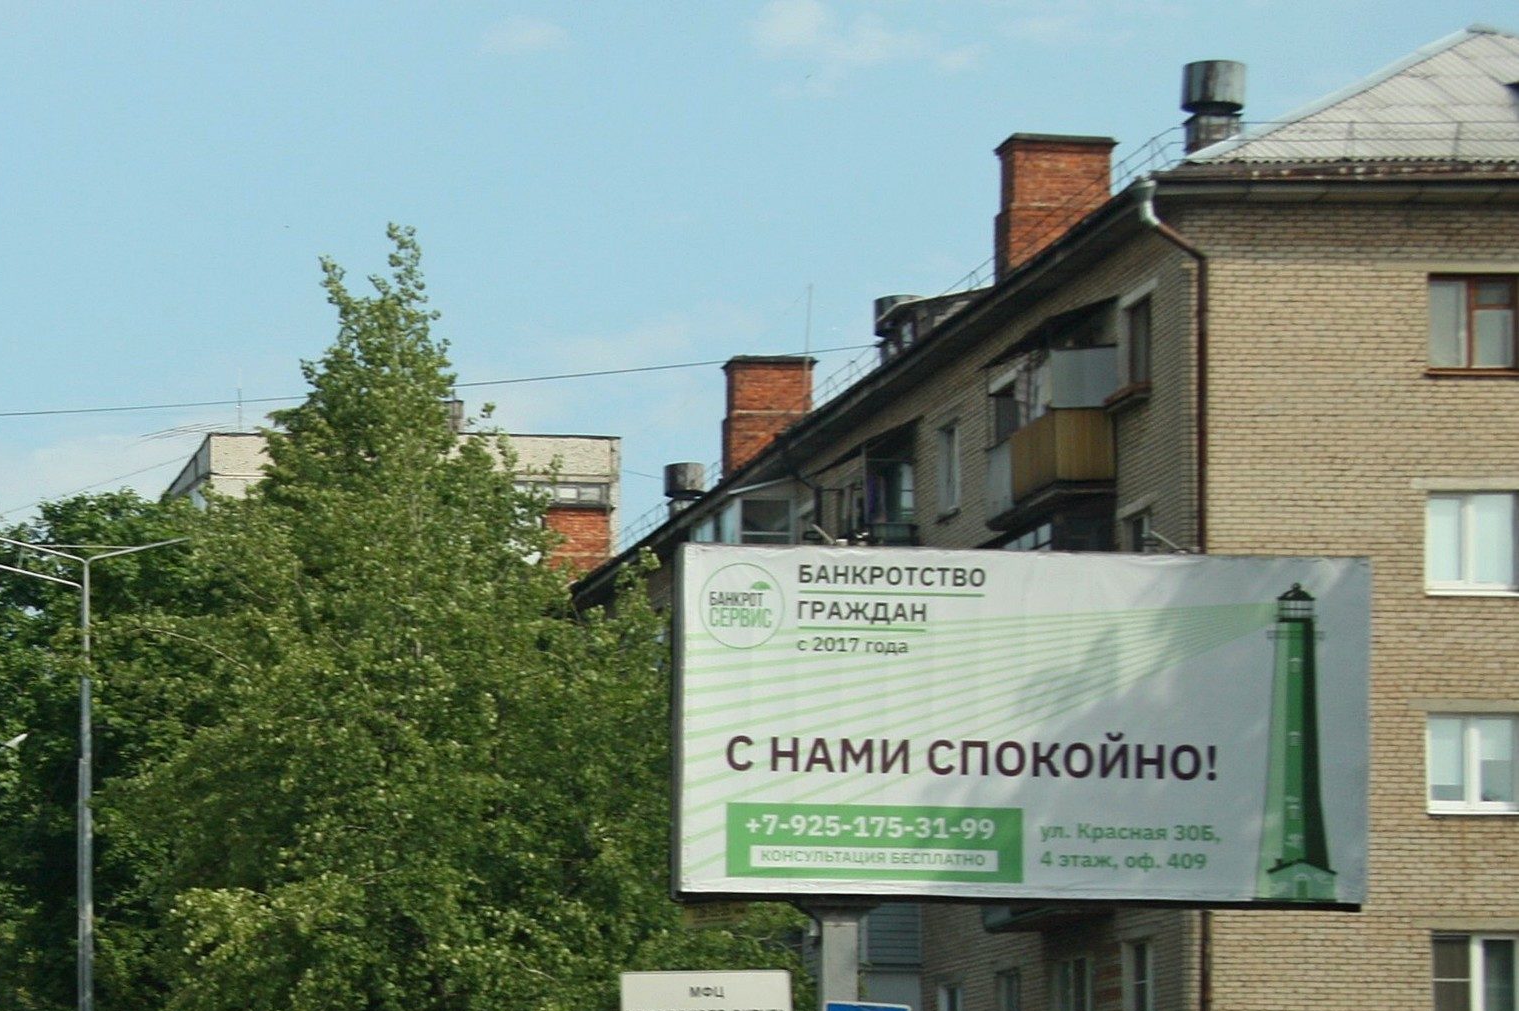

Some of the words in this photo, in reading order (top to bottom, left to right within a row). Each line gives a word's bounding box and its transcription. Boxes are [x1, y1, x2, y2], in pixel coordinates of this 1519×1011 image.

[798, 565, 986, 587] БАНКРОТСТВО
[709, 591, 764, 606] БАНКРОТ
[709, 608, 772, 628] СЕРВИС
[798, 601, 927, 625] ГРАЖДАН
[797, 640, 807, 652] с
[813, 637, 860, 652] 2017
[865, 640, 909, 656] года
[726, 735, 755, 771] С
[770, 737, 910, 775] НАМИ
[927, 732, 1218, 781] СПОКОЙНО!
[745, 814, 995, 840] +7-925-175-31-99
[1040, 826, 1070, 842] ул.
[1077, 823, 1167, 843] Красная
[1174, 824, 1221, 844] 30Б,
[760, 850, 886, 866] КОНСУЛЬТАЦИЯ
[890, 851, 986, 867] БЕСПЛАТНО
[1040, 851, 1052, 867] 4
[1058, 853, 1118, 870] этаж,
[1124, 852, 1161, 872] оф.
[1167, 853, 1207, 869] 409
[689, 986, 725, 999] МФЦ
